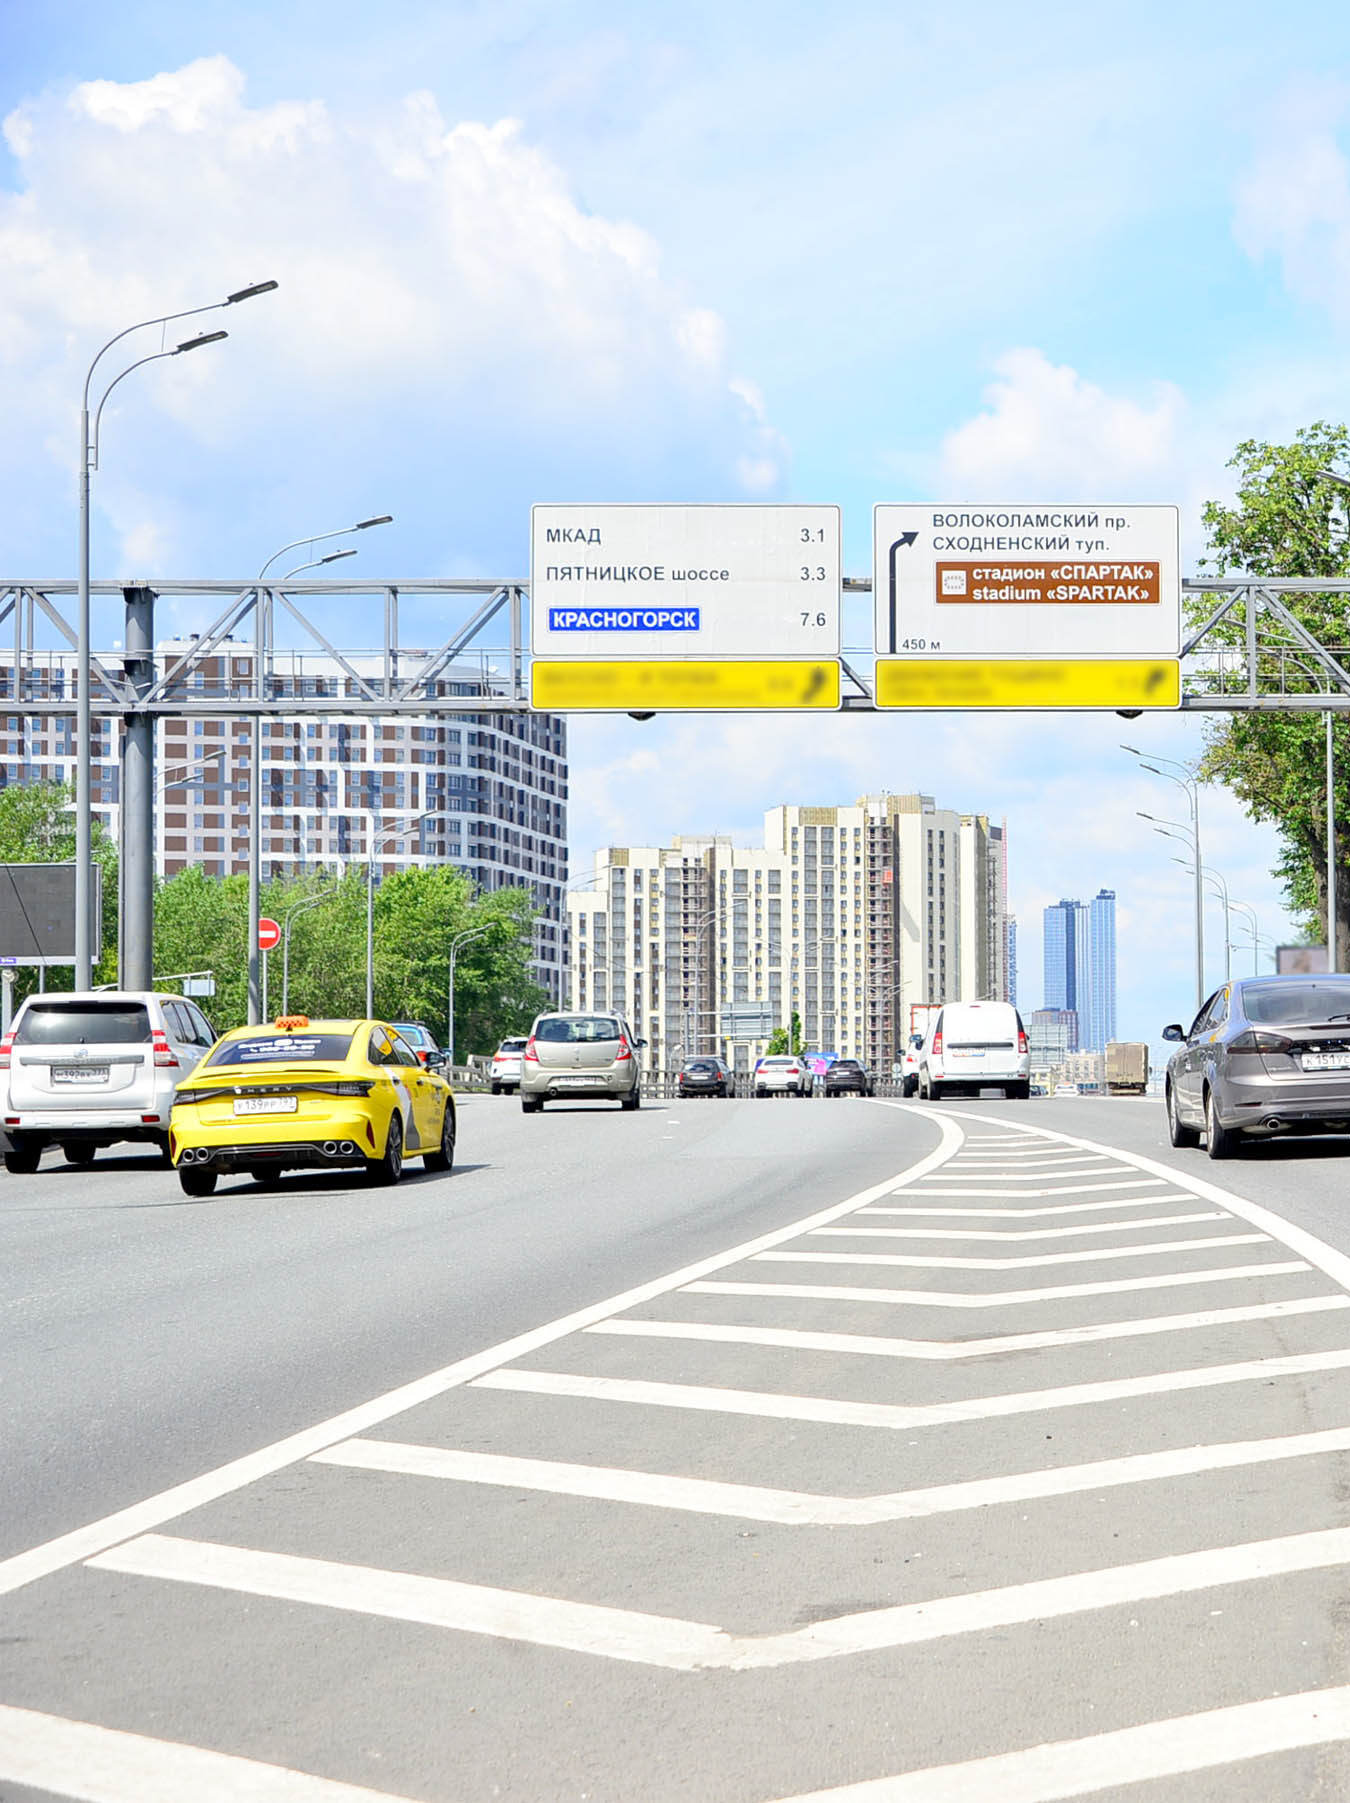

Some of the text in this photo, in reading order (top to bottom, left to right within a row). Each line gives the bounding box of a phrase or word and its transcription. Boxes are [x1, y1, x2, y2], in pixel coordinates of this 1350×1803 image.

[933, 512, 1131, 531] ВОЛОКОЛАМСКИЙ пр.
[546, 528, 825, 545] МКАД 3.1
[933, 534, 1110, 553] СХОДНЕНСКИЙ туп.
[546, 566, 826, 583] ПЯТНИЦКОЕ шоссе 3.3
[972, 565, 1154, 582] стадион «СПАРТАК»
[972, 585, 1150, 600] stadium «SPARTAK»
[553, 611, 826, 628] КРАСНОГОРСК 7.6
[902, 639, 941, 651] 450 м
